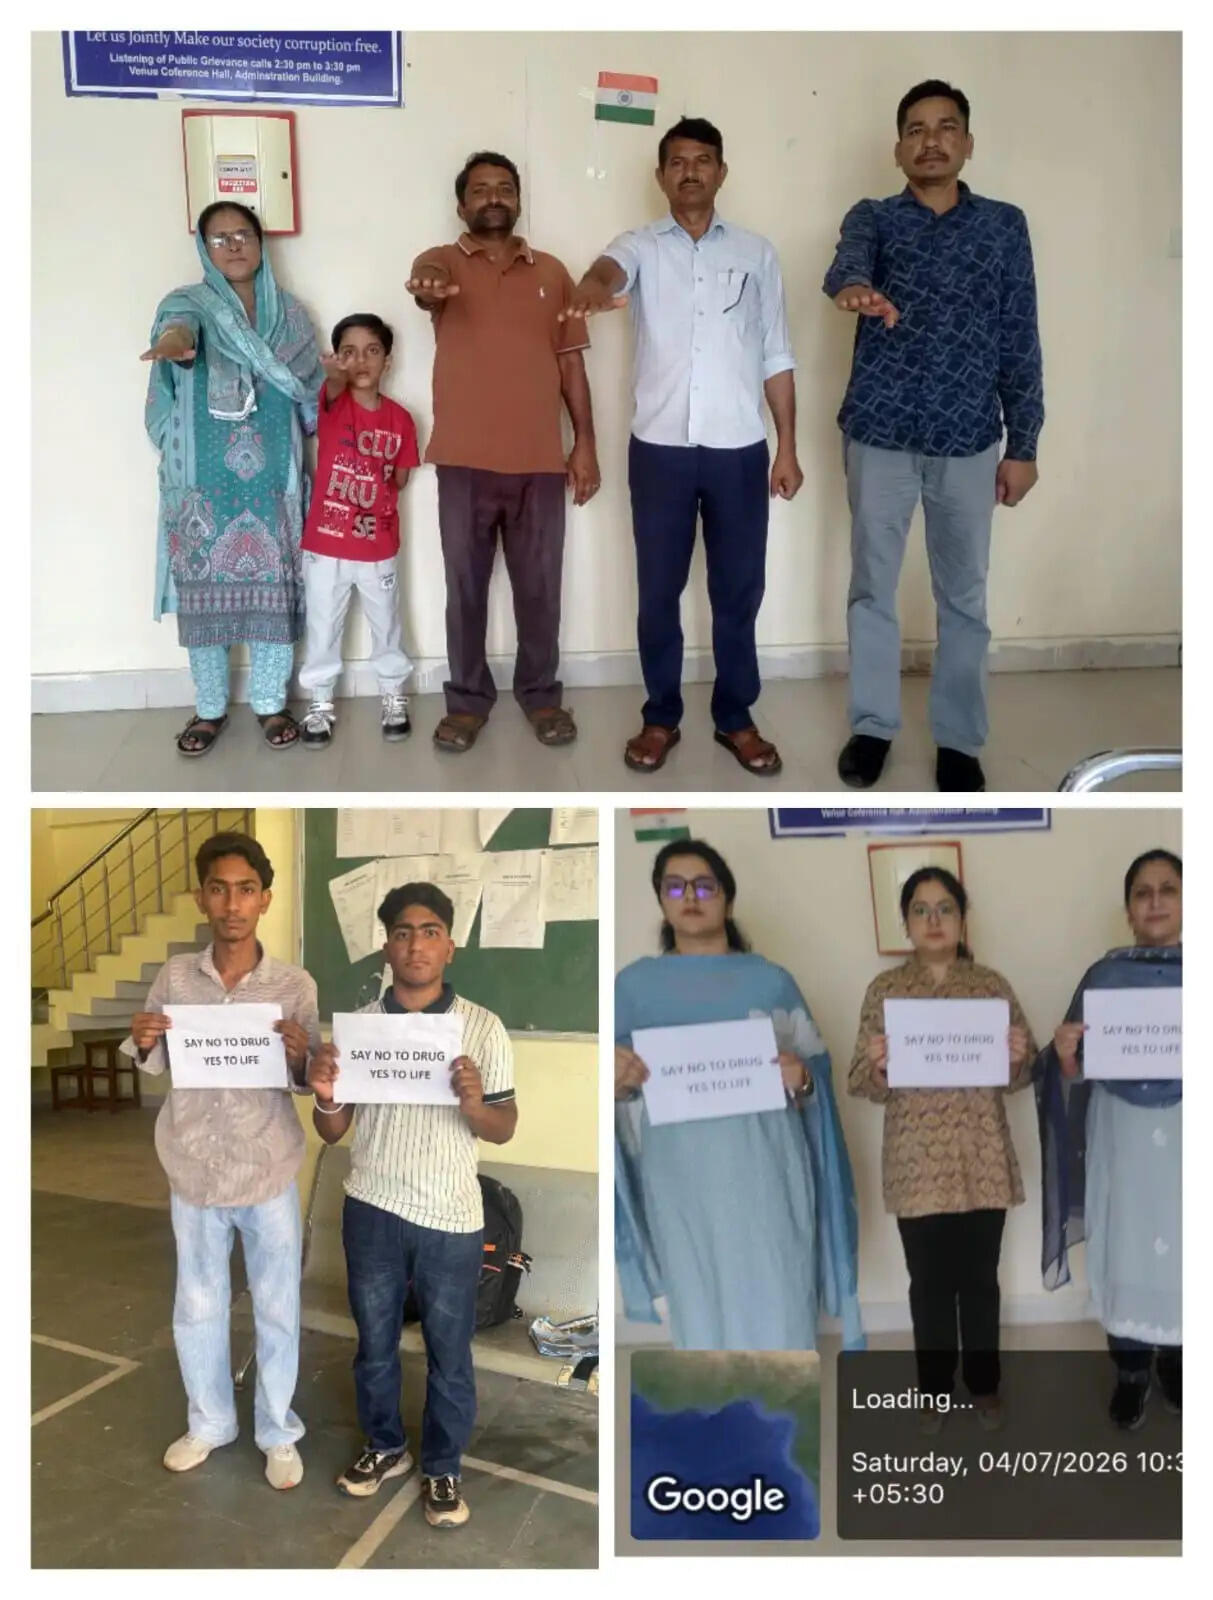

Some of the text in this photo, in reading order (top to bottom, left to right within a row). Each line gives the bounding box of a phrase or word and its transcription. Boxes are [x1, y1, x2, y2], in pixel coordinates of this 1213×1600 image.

[86, 31, 382, 54] Let us Jointly Make our society corruption free.
[109, 53, 154, 65] Listening
[156, 55, 167, 64] of
[168, 55, 198, 65] Public
[200, 56, 248, 67] Grievance
[250, 58, 272, 69] calls
[296, 61, 311, 71] pm
[313, 61, 323, 71] to
[346, 63, 361, 73] pm
[211, 69, 233, 80] Hall,
[1103, 1025, 1122, 1035] SAY
[1125, 1024, 1142, 1034] NO
[1145, 1024, 1159, 1034] TO
[184, 1036, 270, 1048] SAY NO TO DRUG
[203, 1055, 260, 1066] YES TO LIFE
[351, 1050, 445, 1061] SAY NO TO DRUG
[661, 1055, 763, 1077] SAY NO TO DRUG
[369, 1069, 431, 1080] YES TO LIFE
